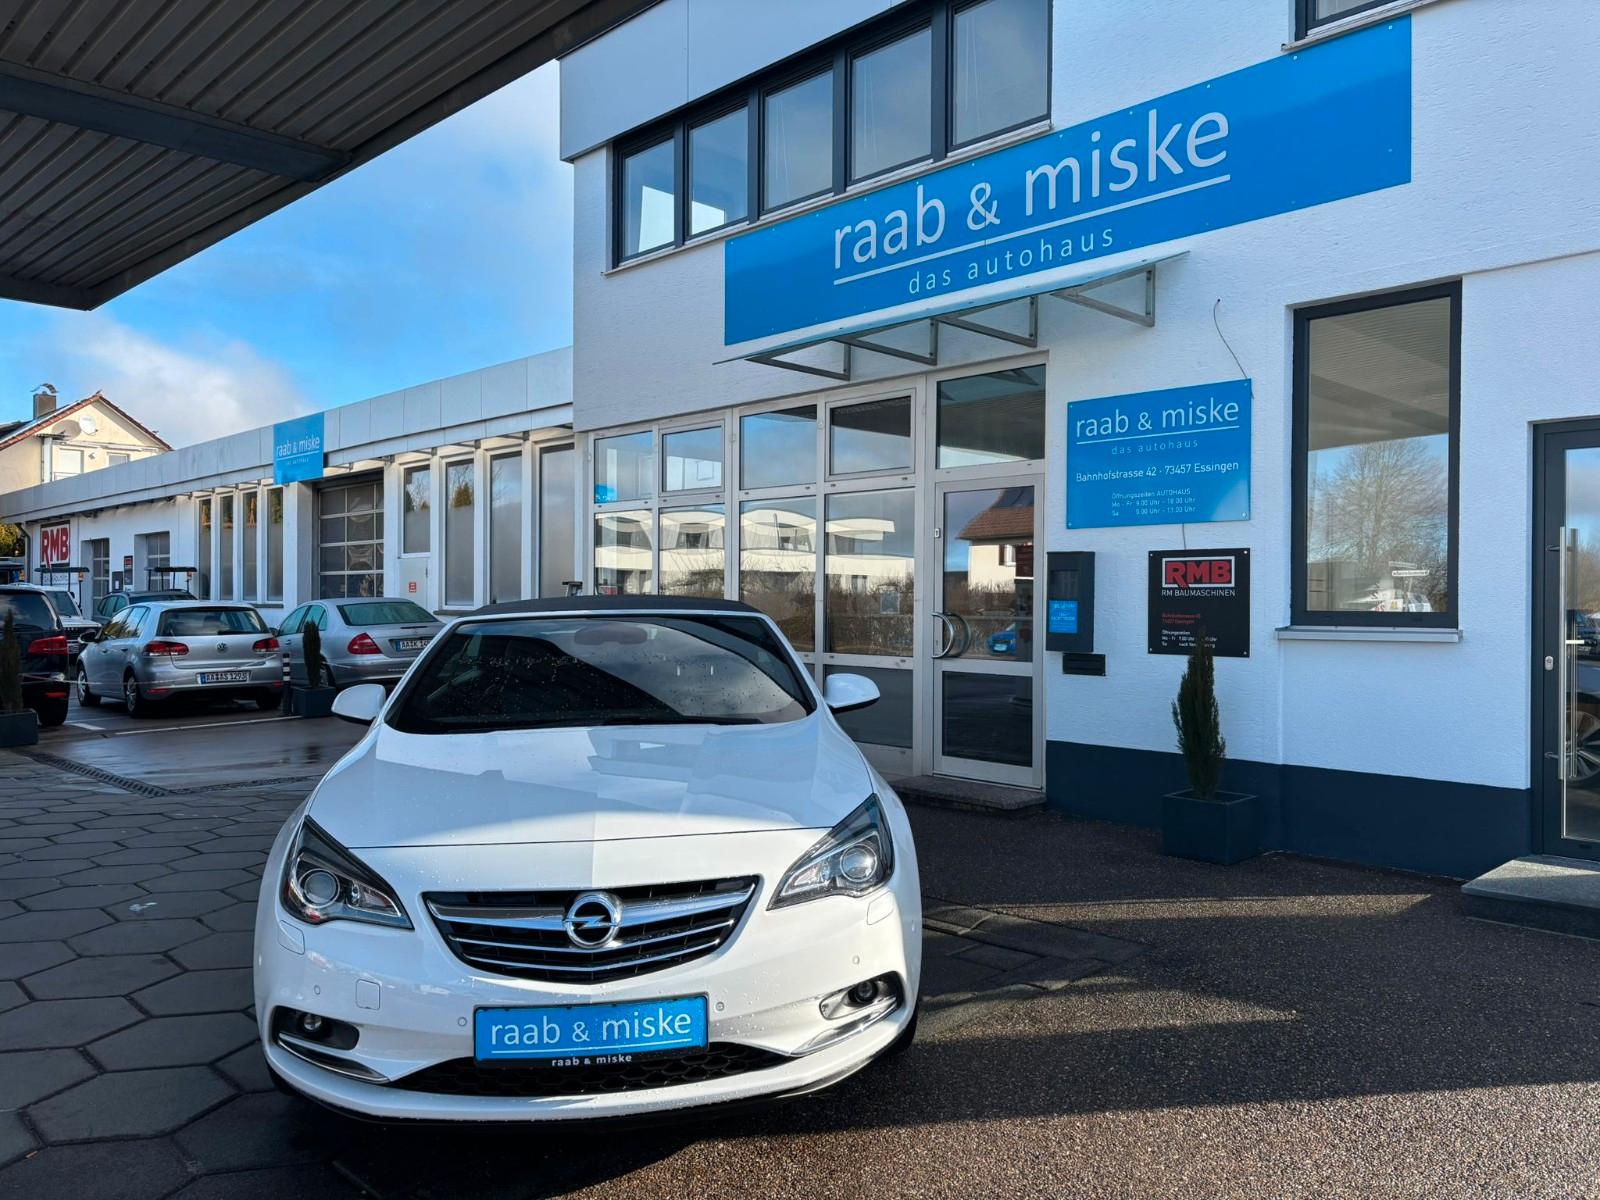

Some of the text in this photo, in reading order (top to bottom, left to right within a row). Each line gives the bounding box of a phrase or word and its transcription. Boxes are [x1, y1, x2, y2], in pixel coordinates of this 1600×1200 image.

[835, 109, 1229, 269] raab & miske
[909, 226, 1114, 294] das autohaus
[1077, 397, 1239, 438] raab & miske
[277, 440, 292, 457] raab
[299, 434, 320, 453] miske
[1112, 439, 1199, 455] das autohaus
[1076, 468, 1144, 482] Bahnhofstrasse
[1146, 466, 1157, 477] 42
[1165, 463, 1192, 475] 73457
[1194, 461, 1239, 474] Essingen
[1156, 487, 1191, 497] AUTOHAUS
[1184, 496, 1196, 504] Uhr
[1184, 505, 1196, 513] Uhr
[41, 527, 70, 568] RMB
[1164, 560, 1232, 589] RMB
[1161, 588, 1236, 598] RM BAUMASCHINEN
[491, 1008, 691, 1045] raab & miske
[551, 1056, 580, 1067] raab
[596, 1054, 632, 1064] miske
